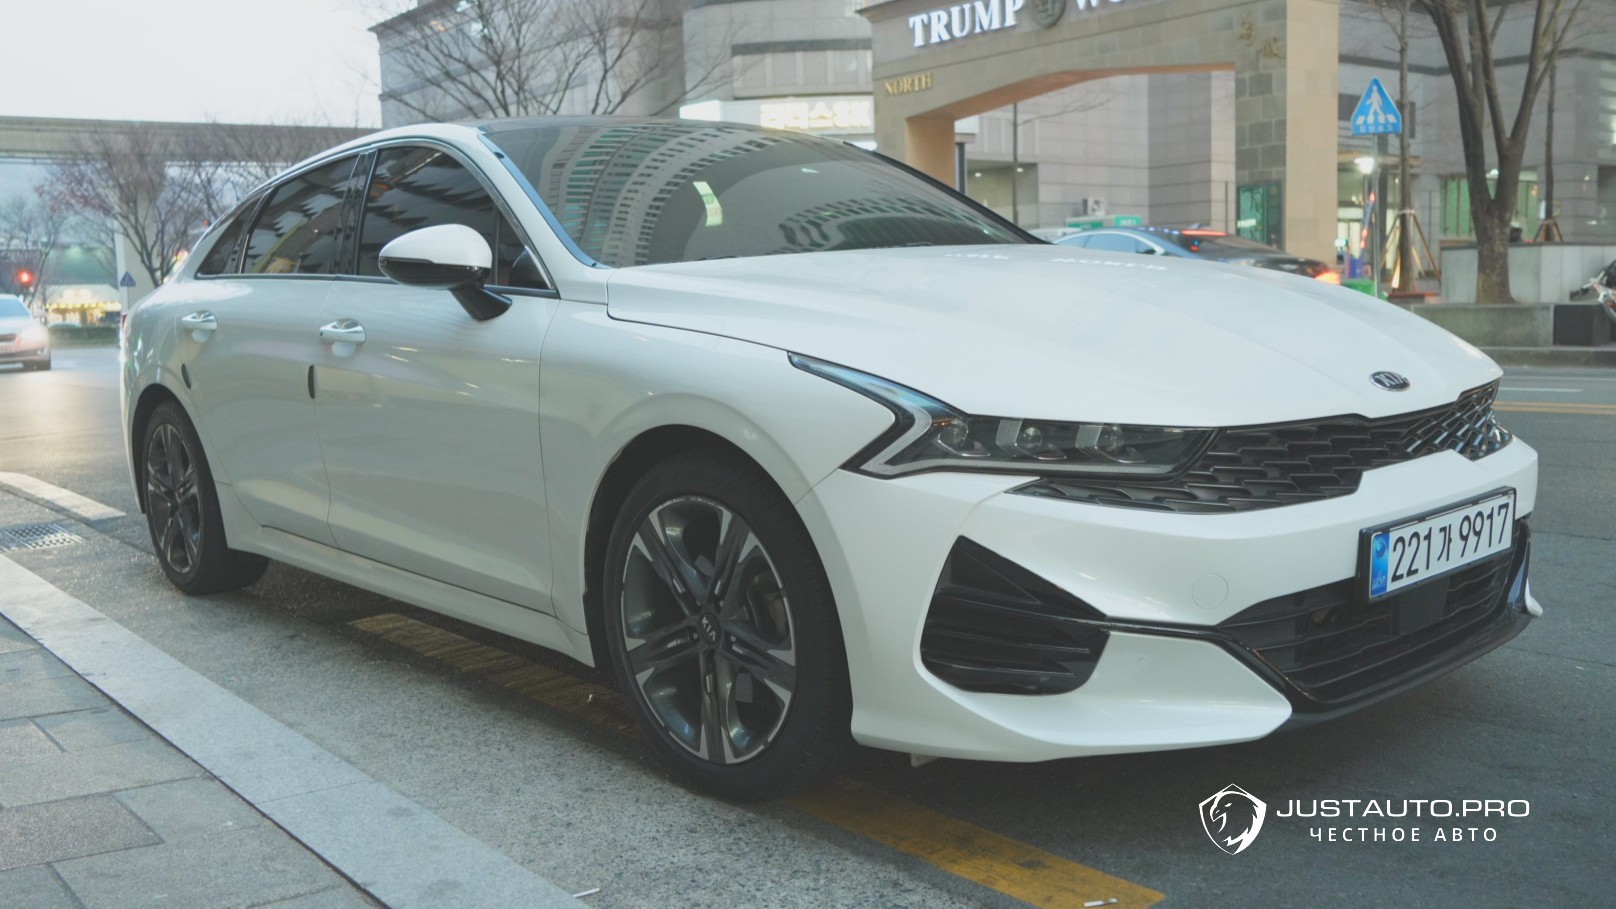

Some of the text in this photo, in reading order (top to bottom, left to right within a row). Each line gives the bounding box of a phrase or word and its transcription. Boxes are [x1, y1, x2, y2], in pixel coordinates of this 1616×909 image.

[909, 0, 1024, 47] TRUMP
[884, 73, 933, 96] NORTH
[1376, 372, 1409, 387] KIA
[1391, 502, 1510, 583] 221가 9917
[701, 616, 716, 641] KIA
